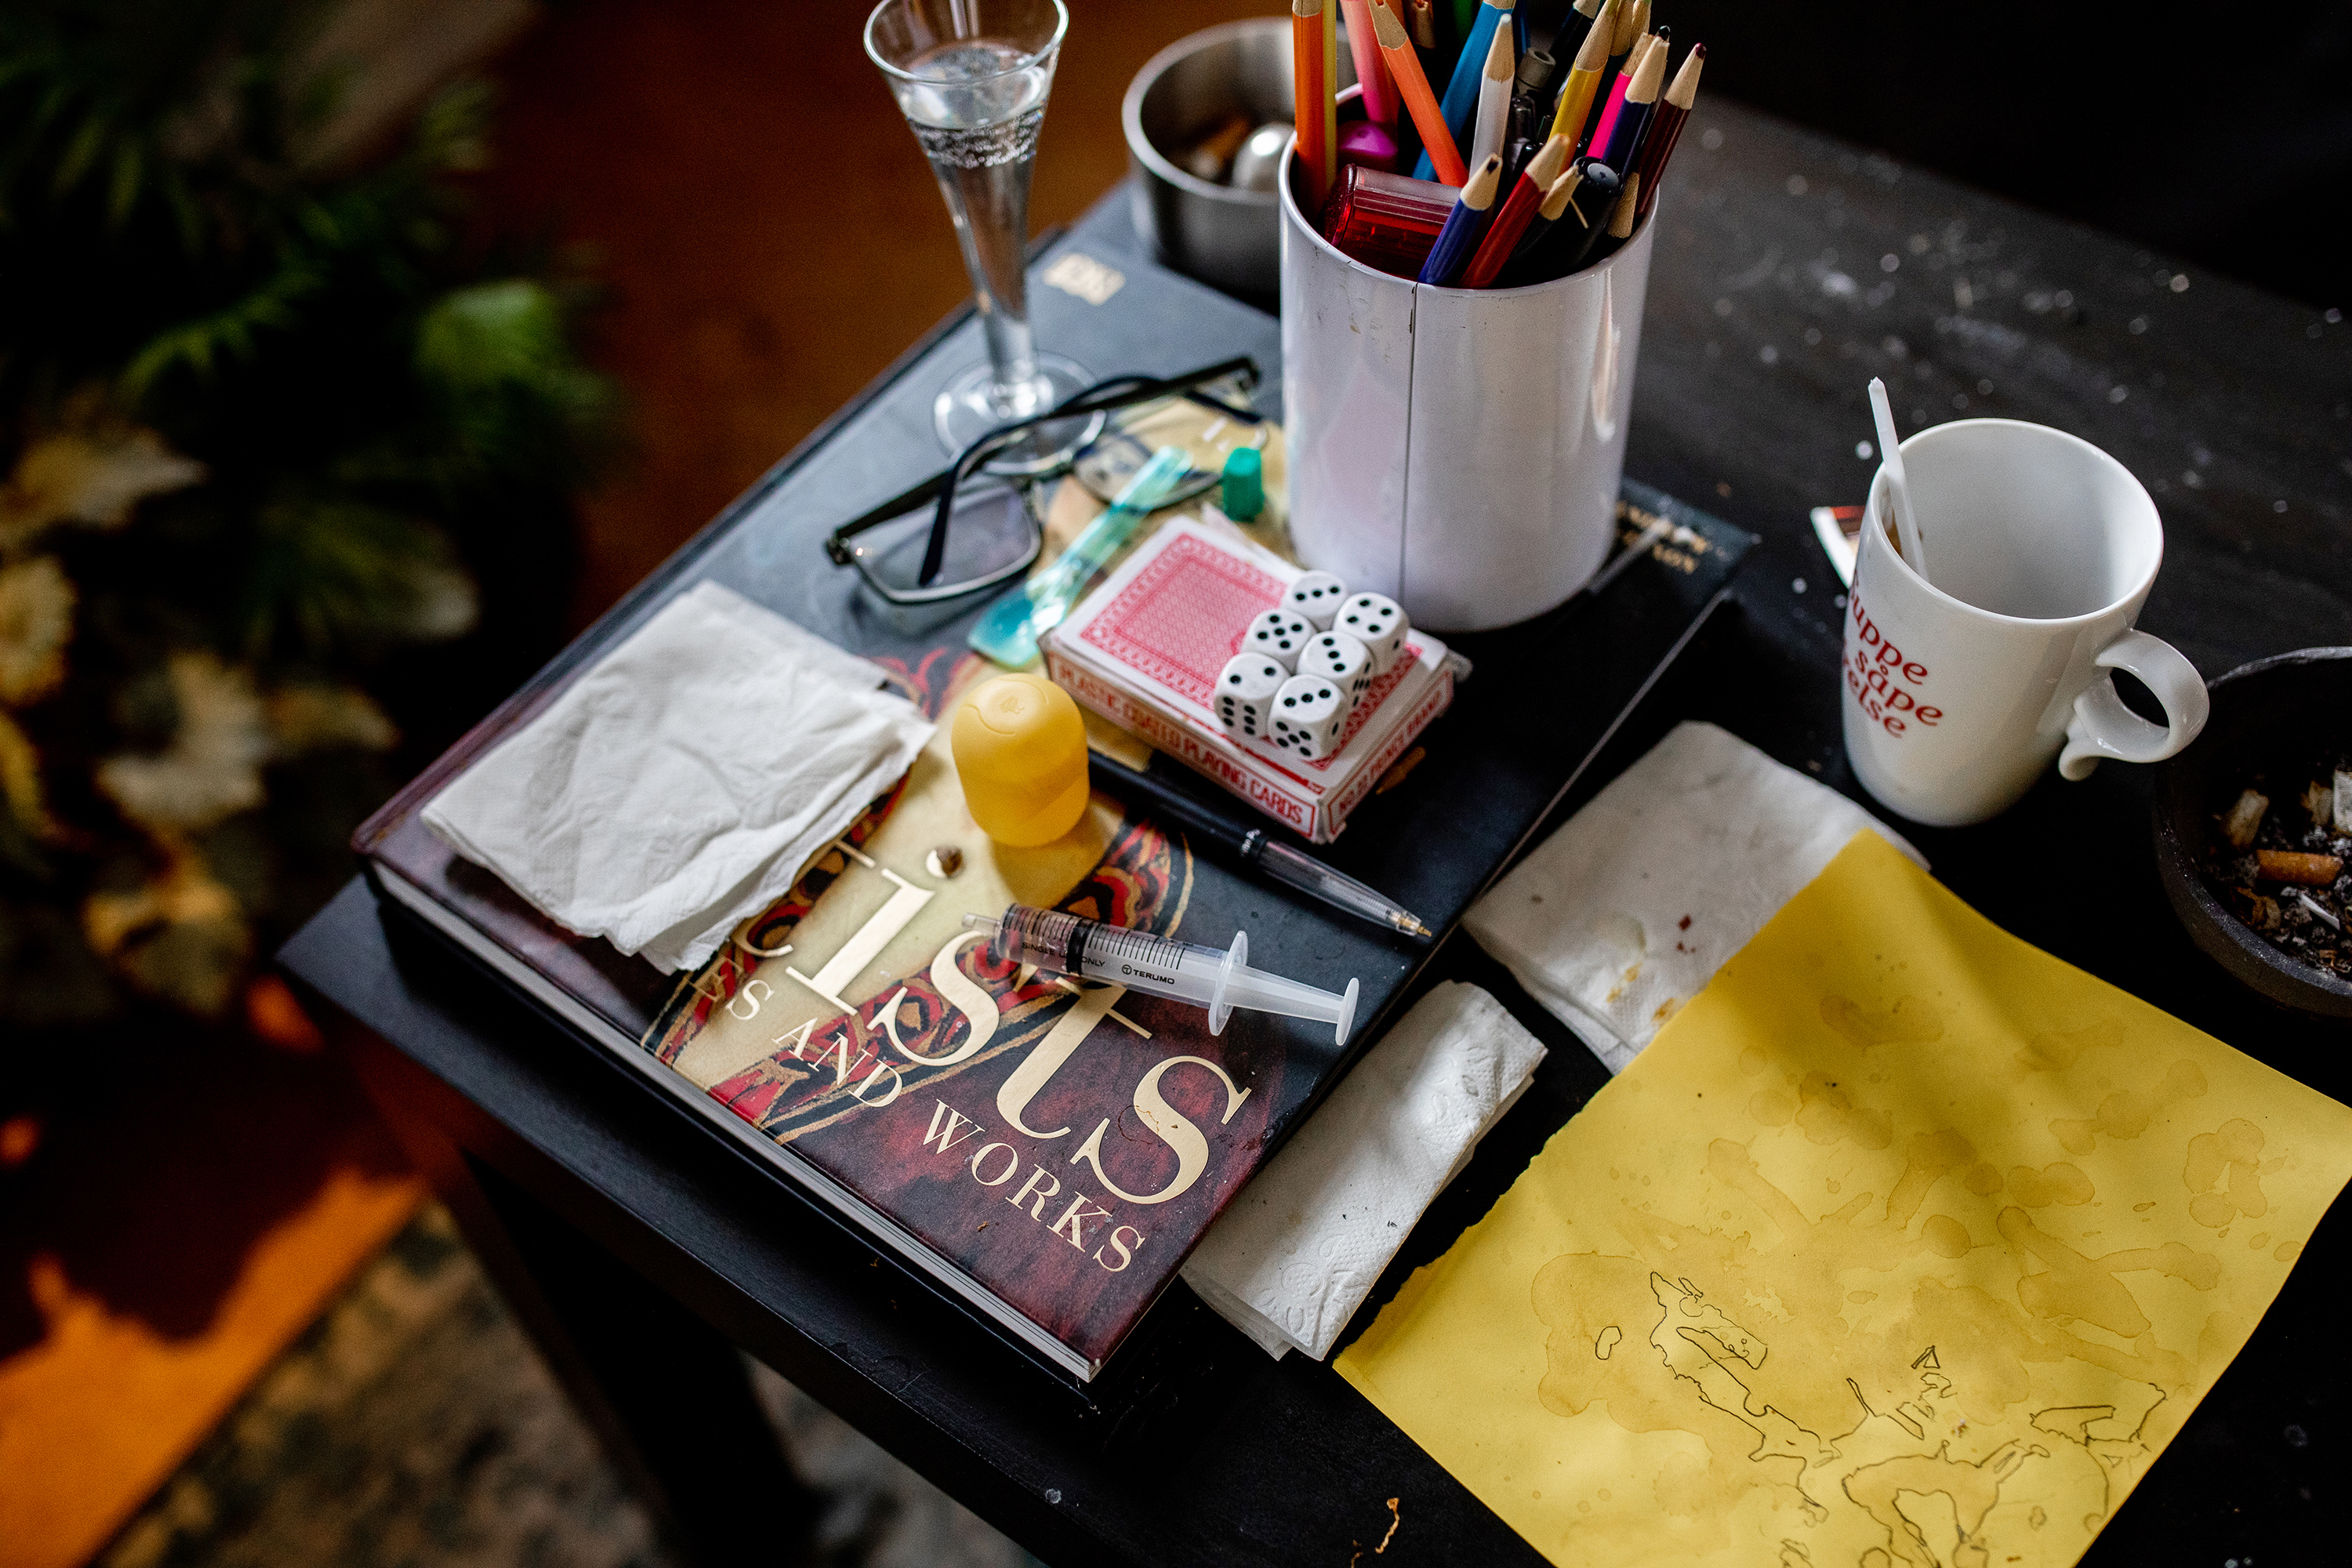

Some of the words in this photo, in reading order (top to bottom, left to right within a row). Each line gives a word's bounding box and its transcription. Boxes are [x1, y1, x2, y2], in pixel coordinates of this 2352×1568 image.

[1843, 655, 1907, 739] else
[1855, 649, 1943, 727] såpe
[1183, 735, 1247, 790] PLAYING
[1249, 776, 1304, 826] CARDS
[1022, 942, 1056, 956] SINGLE
[1080, 956, 1105, 967] ONLY
[1134, 969, 1175, 984] TERUMO
[771, 1017, 902, 1109] AND
[922, 1099, 1146, 1272] WORKS
